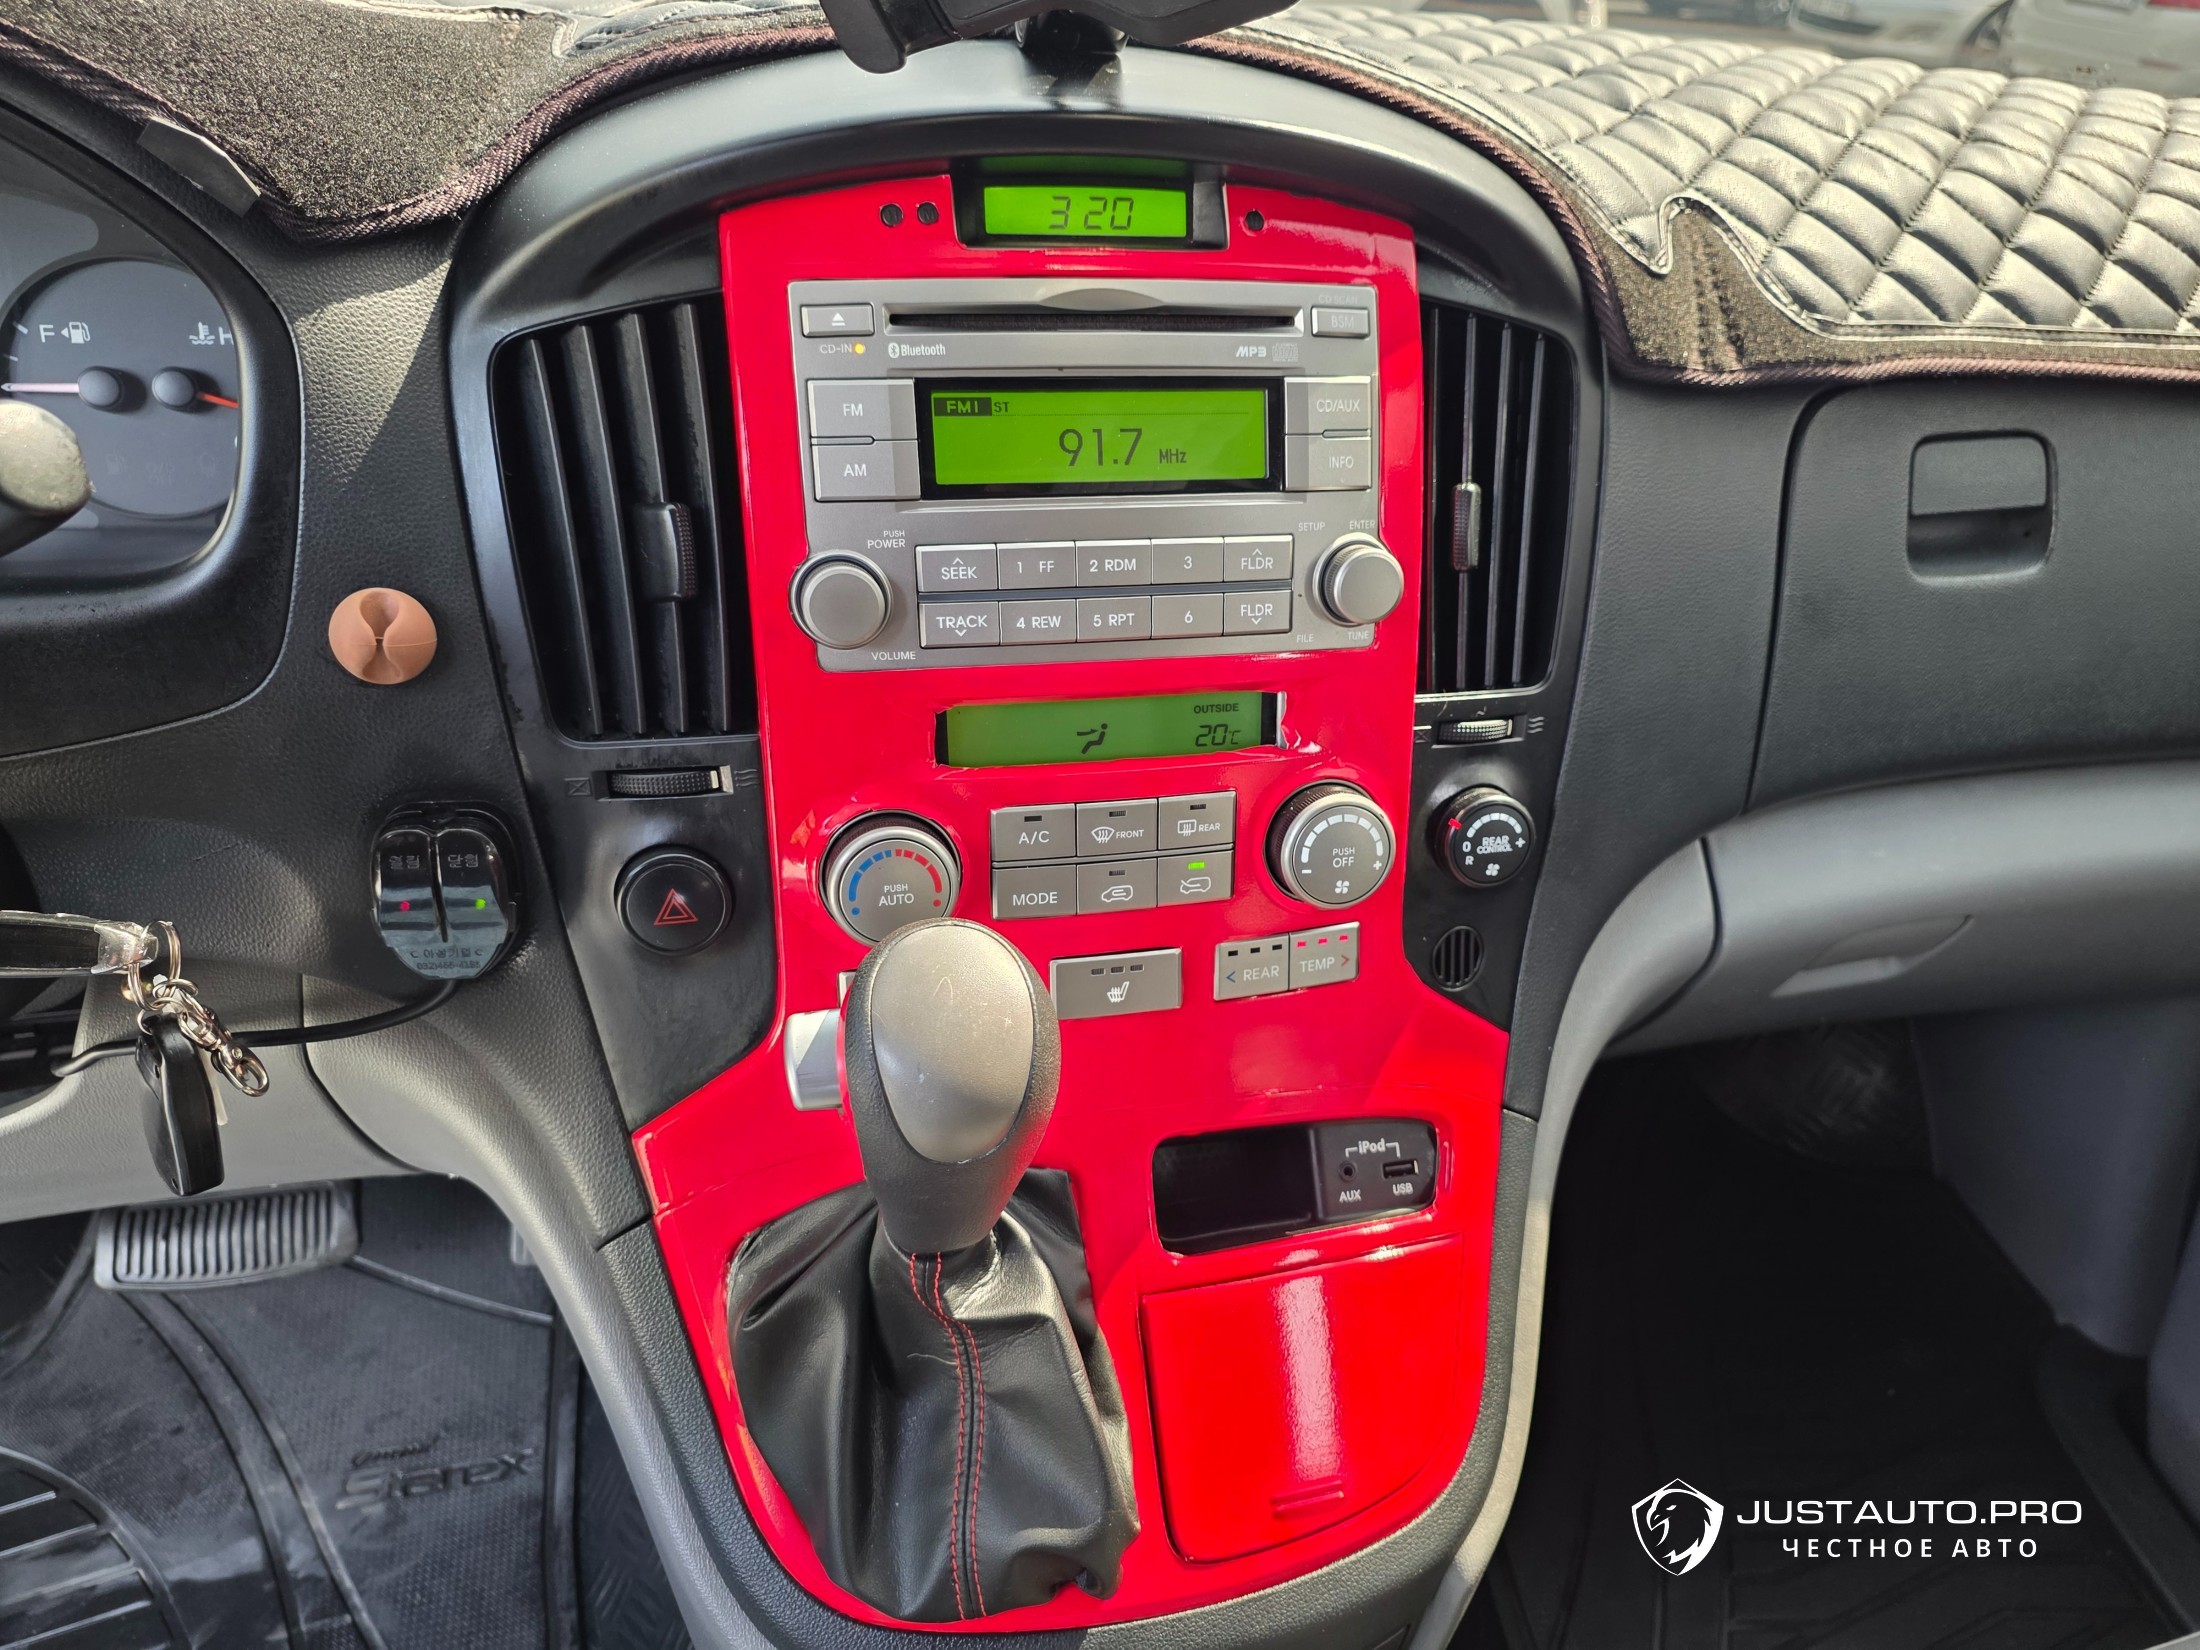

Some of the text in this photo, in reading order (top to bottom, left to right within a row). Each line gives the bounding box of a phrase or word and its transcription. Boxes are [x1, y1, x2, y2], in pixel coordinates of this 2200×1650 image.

[1331, 314, 1355, 328] BSM
[38, 324, 55, 343] F
[820, 343, 852, 355] CD-IN
[900, 343, 946, 357] Bluetooth
[1235, 345, 1267, 358] MP3
[842, 403, 864, 418] FM
[994, 402, 1010, 413] ST
[1316, 399, 1361, 413] CD/AUX
[1058, 428, 1187, 468] 91.7 MHz
[1328, 455, 1355, 469] INFO
[843, 463, 868, 478] AM
[1298, 521, 1326, 533] SETUP
[1348, 519, 1376, 531] ENTER
[883, 529, 906, 538] PUSH
[867, 538, 906, 550] POWER
[1016, 560, 1055, 574] 1 FF
[1089, 558, 1137, 573] 2 RDM
[1183, 555, 1193, 570] 3
[1240, 557, 1274, 571] FLDR
[941, 565, 978, 580] SEEK
[1184, 610, 1194, 624] 6
[1240, 603, 1273, 617] FLDR
[936, 614, 988, 630] TRACK
[1016, 615, 1061, 630] 4 REW
[1092, 612, 1135, 627] 5 RPT
[1296, 632, 1314, 643] FILE
[1347, 630, 1370, 641] TUNE
[871, 651, 917, 661] VOLUME
[1193, 702, 1240, 715] OUTSIDE
[1115, 828, 1145, 839] FRONT
[1198, 821, 1221, 833] REAR
[1018, 829, 1050, 845] A/C
[1482, 835, 1510, 847] REAR
[1332, 847, 1356, 857] PUSH
[1476, 844, 1514, 854] CONTROL
[1332, 857, 1355, 868] OFF
[1464, 855, 1475, 866] R
[884, 883, 909, 894] PUSH
[878, 893, 915, 907] AUTO
[1012, 890, 1058, 906] MODE
[1299, 956, 1336, 974] TEMP
[1243, 964, 1280, 982] REAR
[1358, 1137, 1387, 1155] iPod
[1339, 1188, 1362, 1203] AUX
[1392, 1182, 1414, 1197] USB
